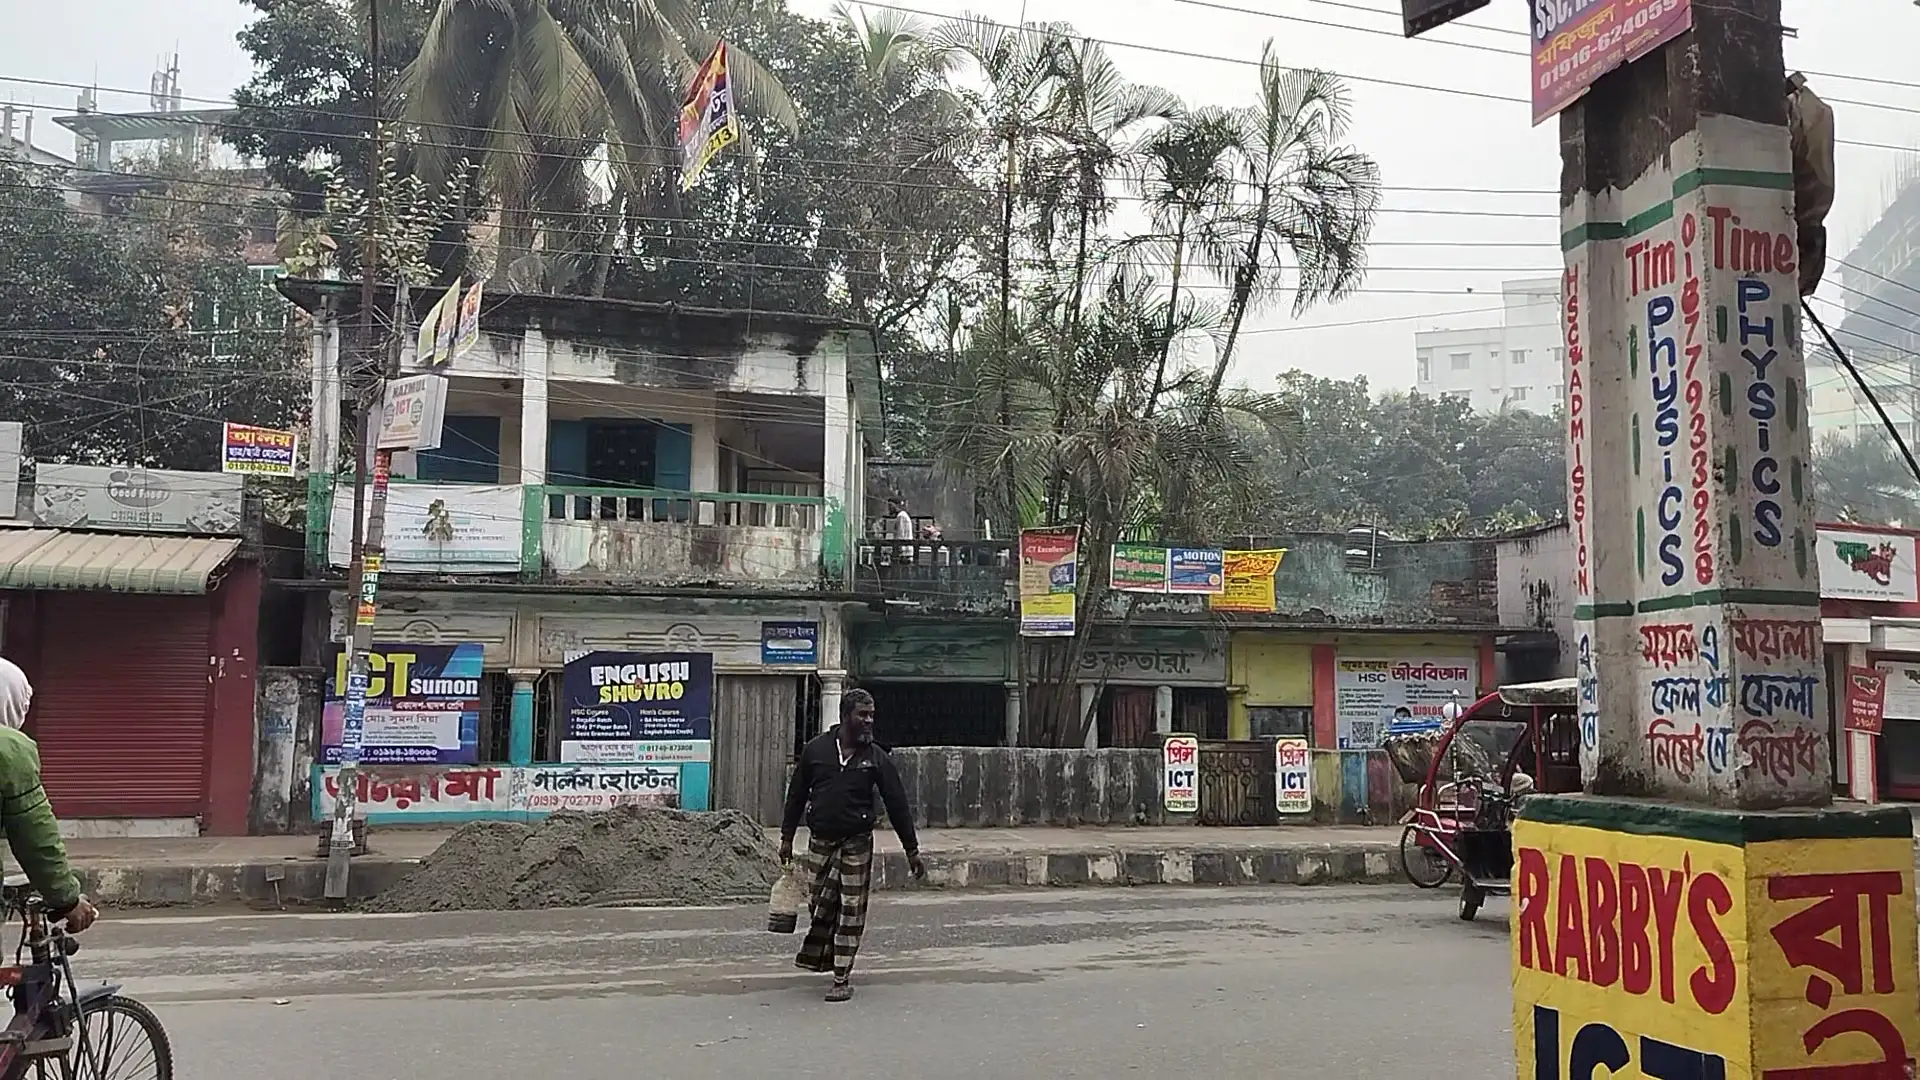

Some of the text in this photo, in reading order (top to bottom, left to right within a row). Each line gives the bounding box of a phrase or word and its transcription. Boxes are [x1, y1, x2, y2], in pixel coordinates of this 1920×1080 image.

[1540, 0, 1678, 90] 01916-624059
[1707, 206, 1796, 274] Time
[396, 399, 411, 415] ICT
[1183, 551, 1221, 561] MOTION
[1731, 620, 1822, 666] ময়লা
[335, 652, 416, 697] ICT
[590, 661, 689, 686] ENGLISH
[1358, 673, 1387, 682] HSC
[1391, 662, 1468, 681] জীববিজ্ঞান
[411, 678, 478, 695] sumon
[600, 682, 684, 703] SHUVRO
[1741, 674, 1820, 719] ফেলা
[365, 713, 438, 725] মোঃ সুমন মিয়া
[1413, 706, 1444, 716] BIOLOG
[1738, 719, 1822, 787] নিষেধ
[533, 769, 595, 792] গার্লস
[598, 767, 678, 792] হোস্টেল
[1168, 771, 1194, 787] ICT
[1281, 772, 1307, 789] ICT
[1518, 847, 1737, 1015] RABBY'S
